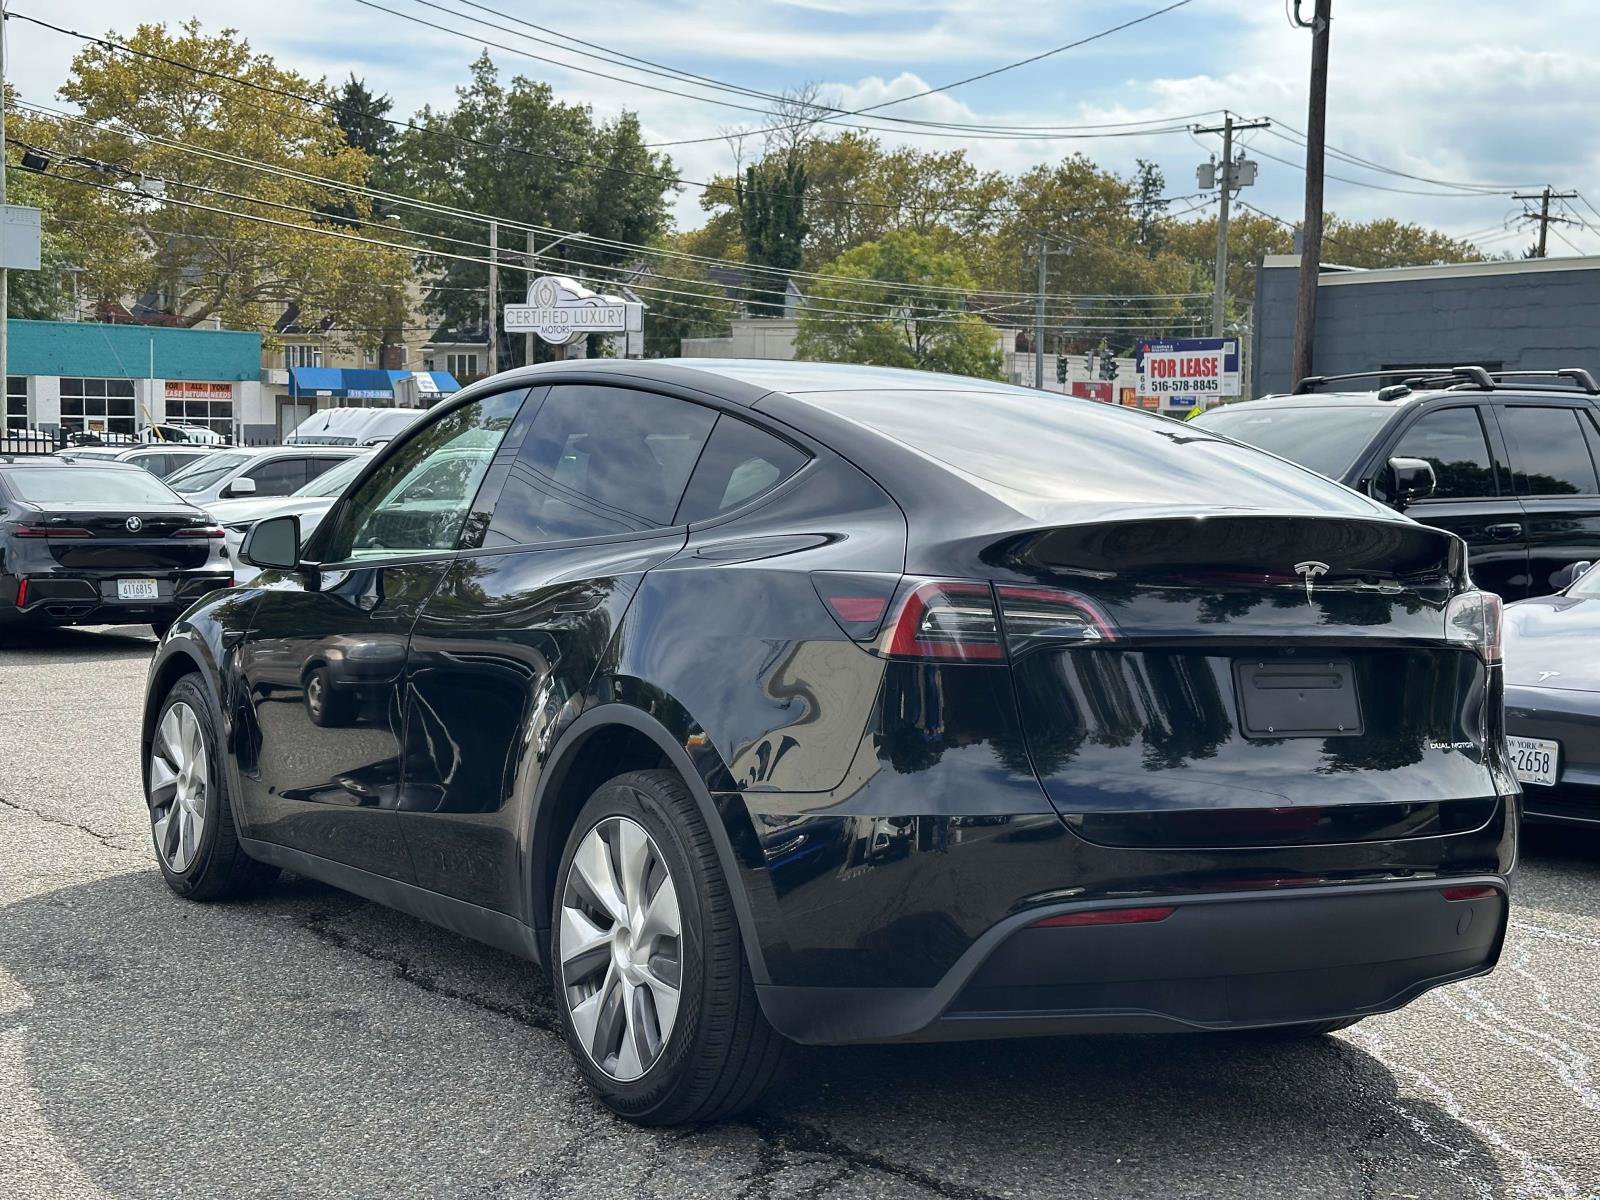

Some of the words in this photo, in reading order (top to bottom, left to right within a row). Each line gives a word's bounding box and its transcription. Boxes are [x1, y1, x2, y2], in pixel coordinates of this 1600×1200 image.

[506, 310, 569, 325] CERTIFIED
[574, 309, 624, 324] LUXURY
[541, 325, 570, 334] MOTORS
[1151, 358, 1177, 379] FOR
[1180, 357, 1218, 378] LEASE
[211, 383, 230, 391] YOUR
[1151, 379, 1218, 392] 516-578-8845
[210, 391, 232, 399] NEEDS
[1450, 741, 1475, 749] MOTOR
[1517, 741, 1538, 750] YORK
[1517, 749, 1550, 774] 2658
